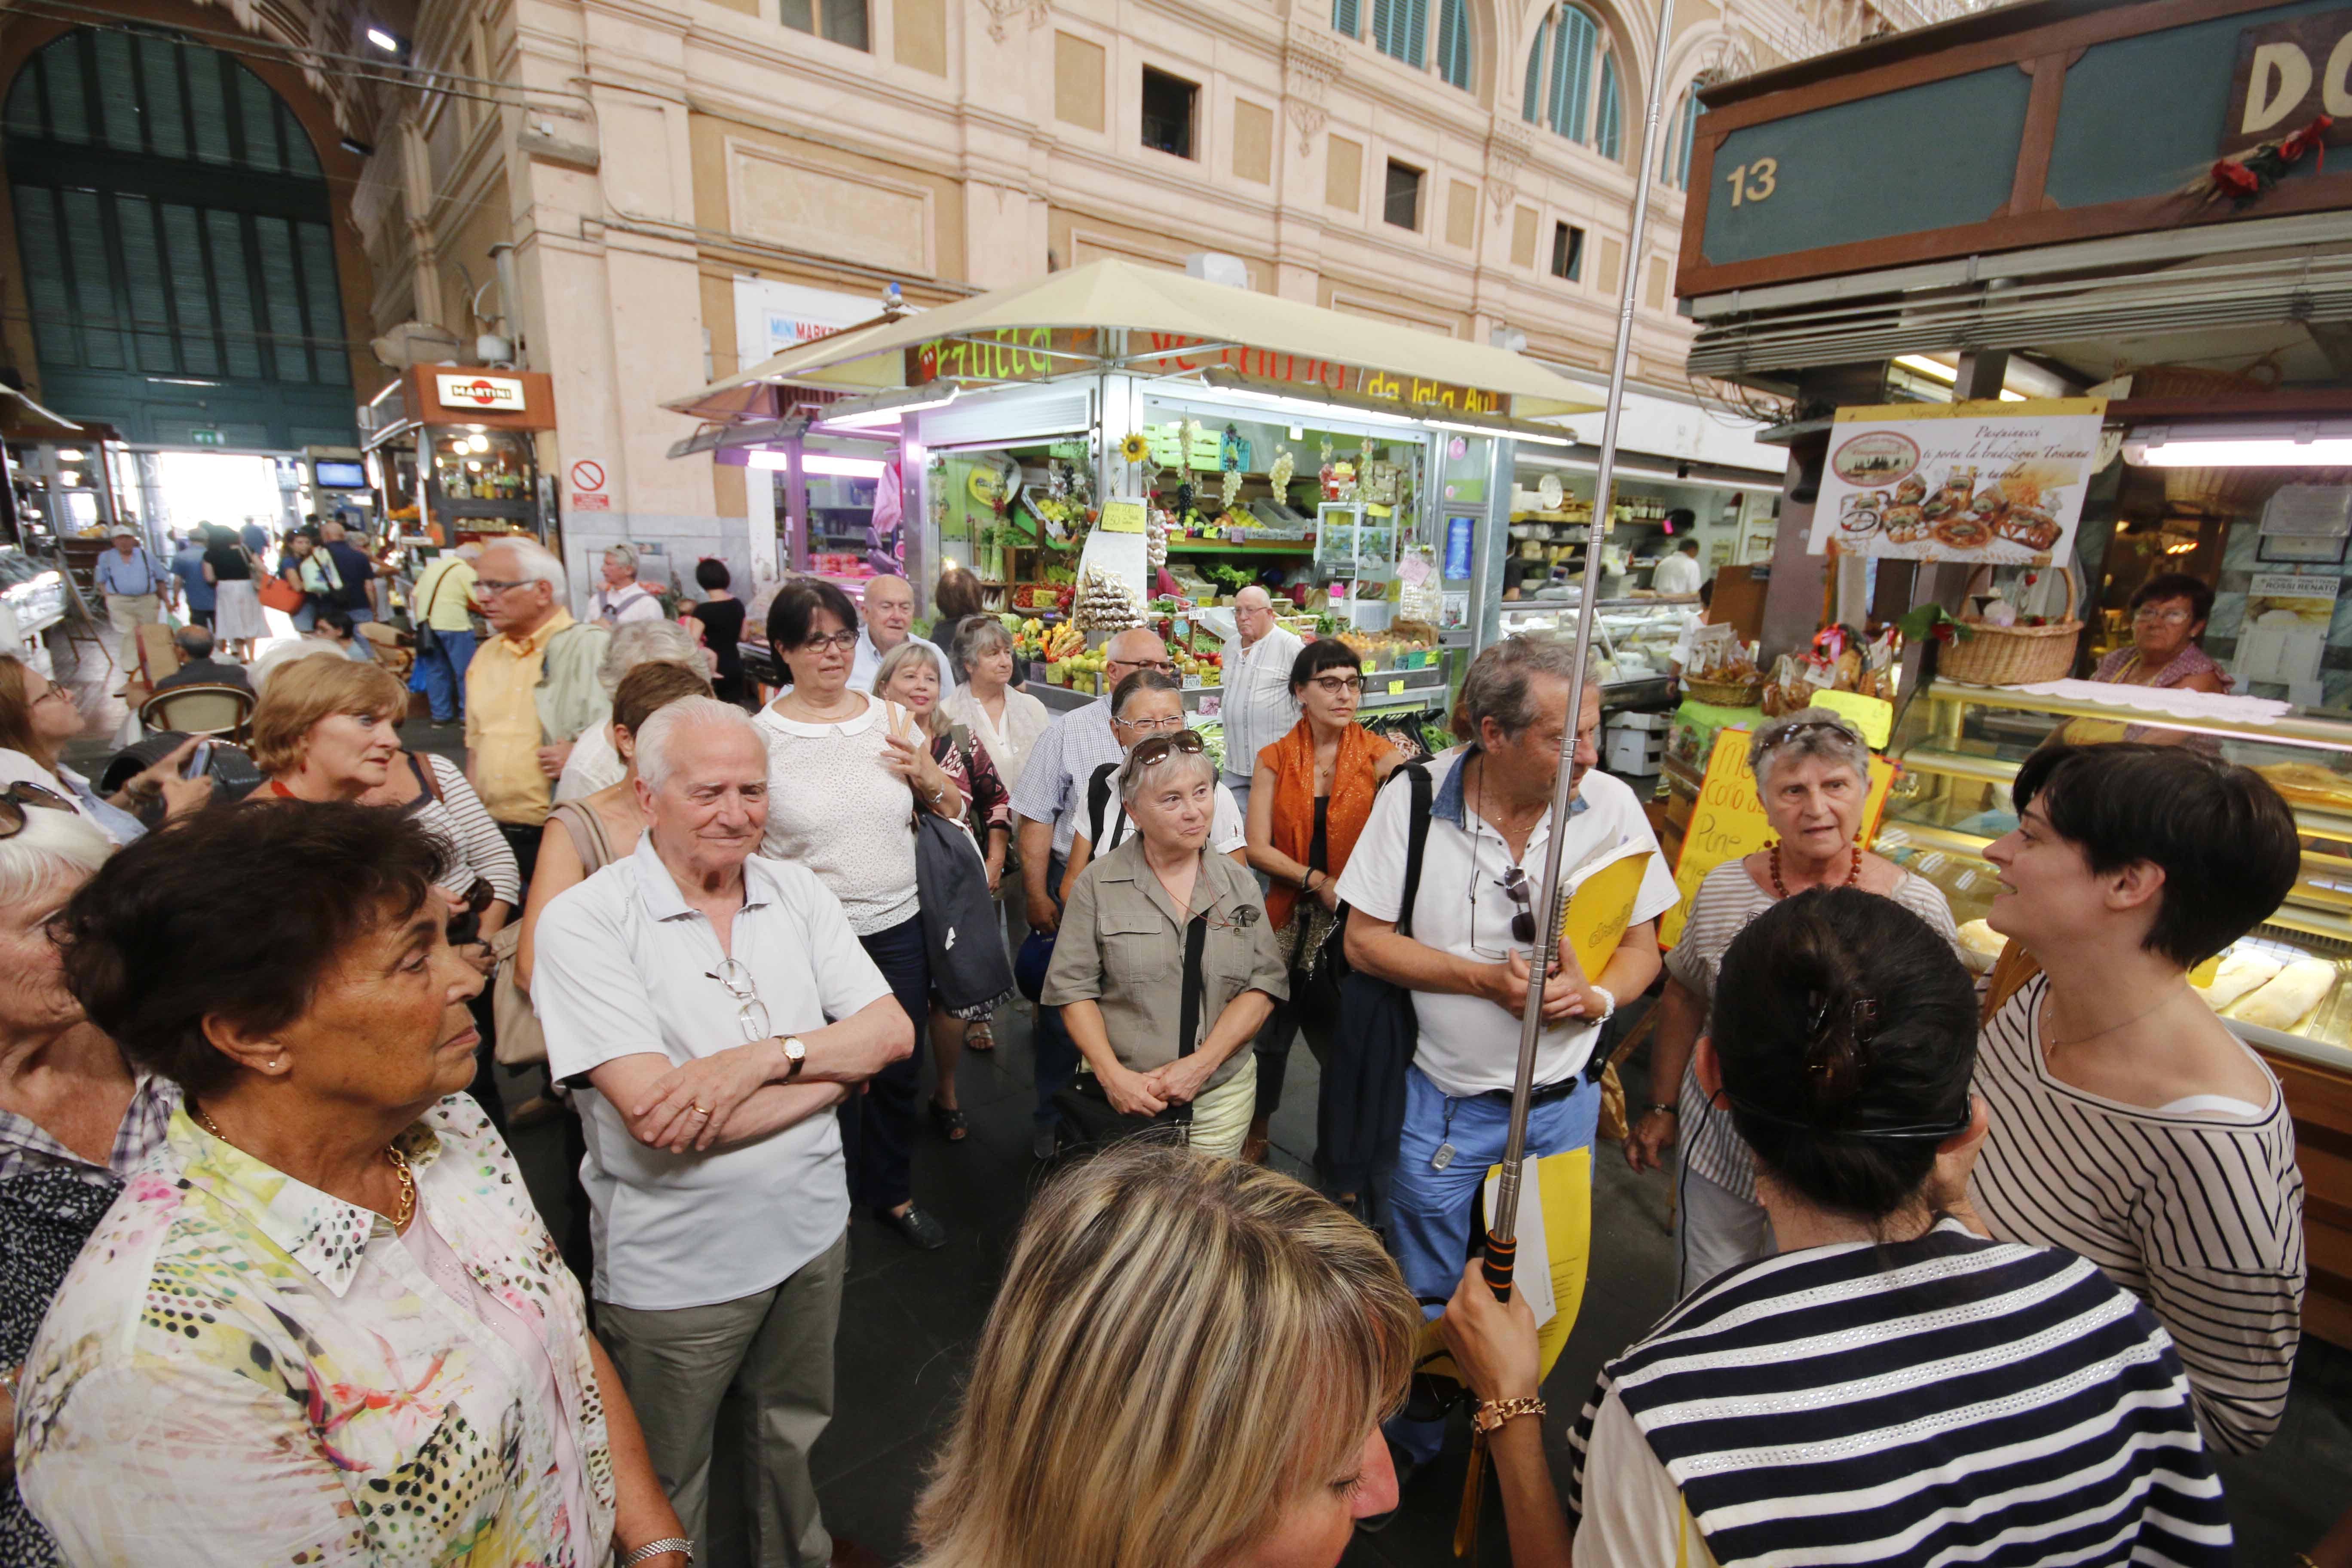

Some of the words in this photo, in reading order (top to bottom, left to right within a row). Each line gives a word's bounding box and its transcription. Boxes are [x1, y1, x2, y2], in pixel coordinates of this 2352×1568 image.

[1726, 157, 1778, 208] 13
[452, 385, 511, 400] MARTINI
[1981, 438, 2039, 462] tradizione
[2297, 583, 2337, 592] RENATO
[1697, 813, 1741, 858] Pane
